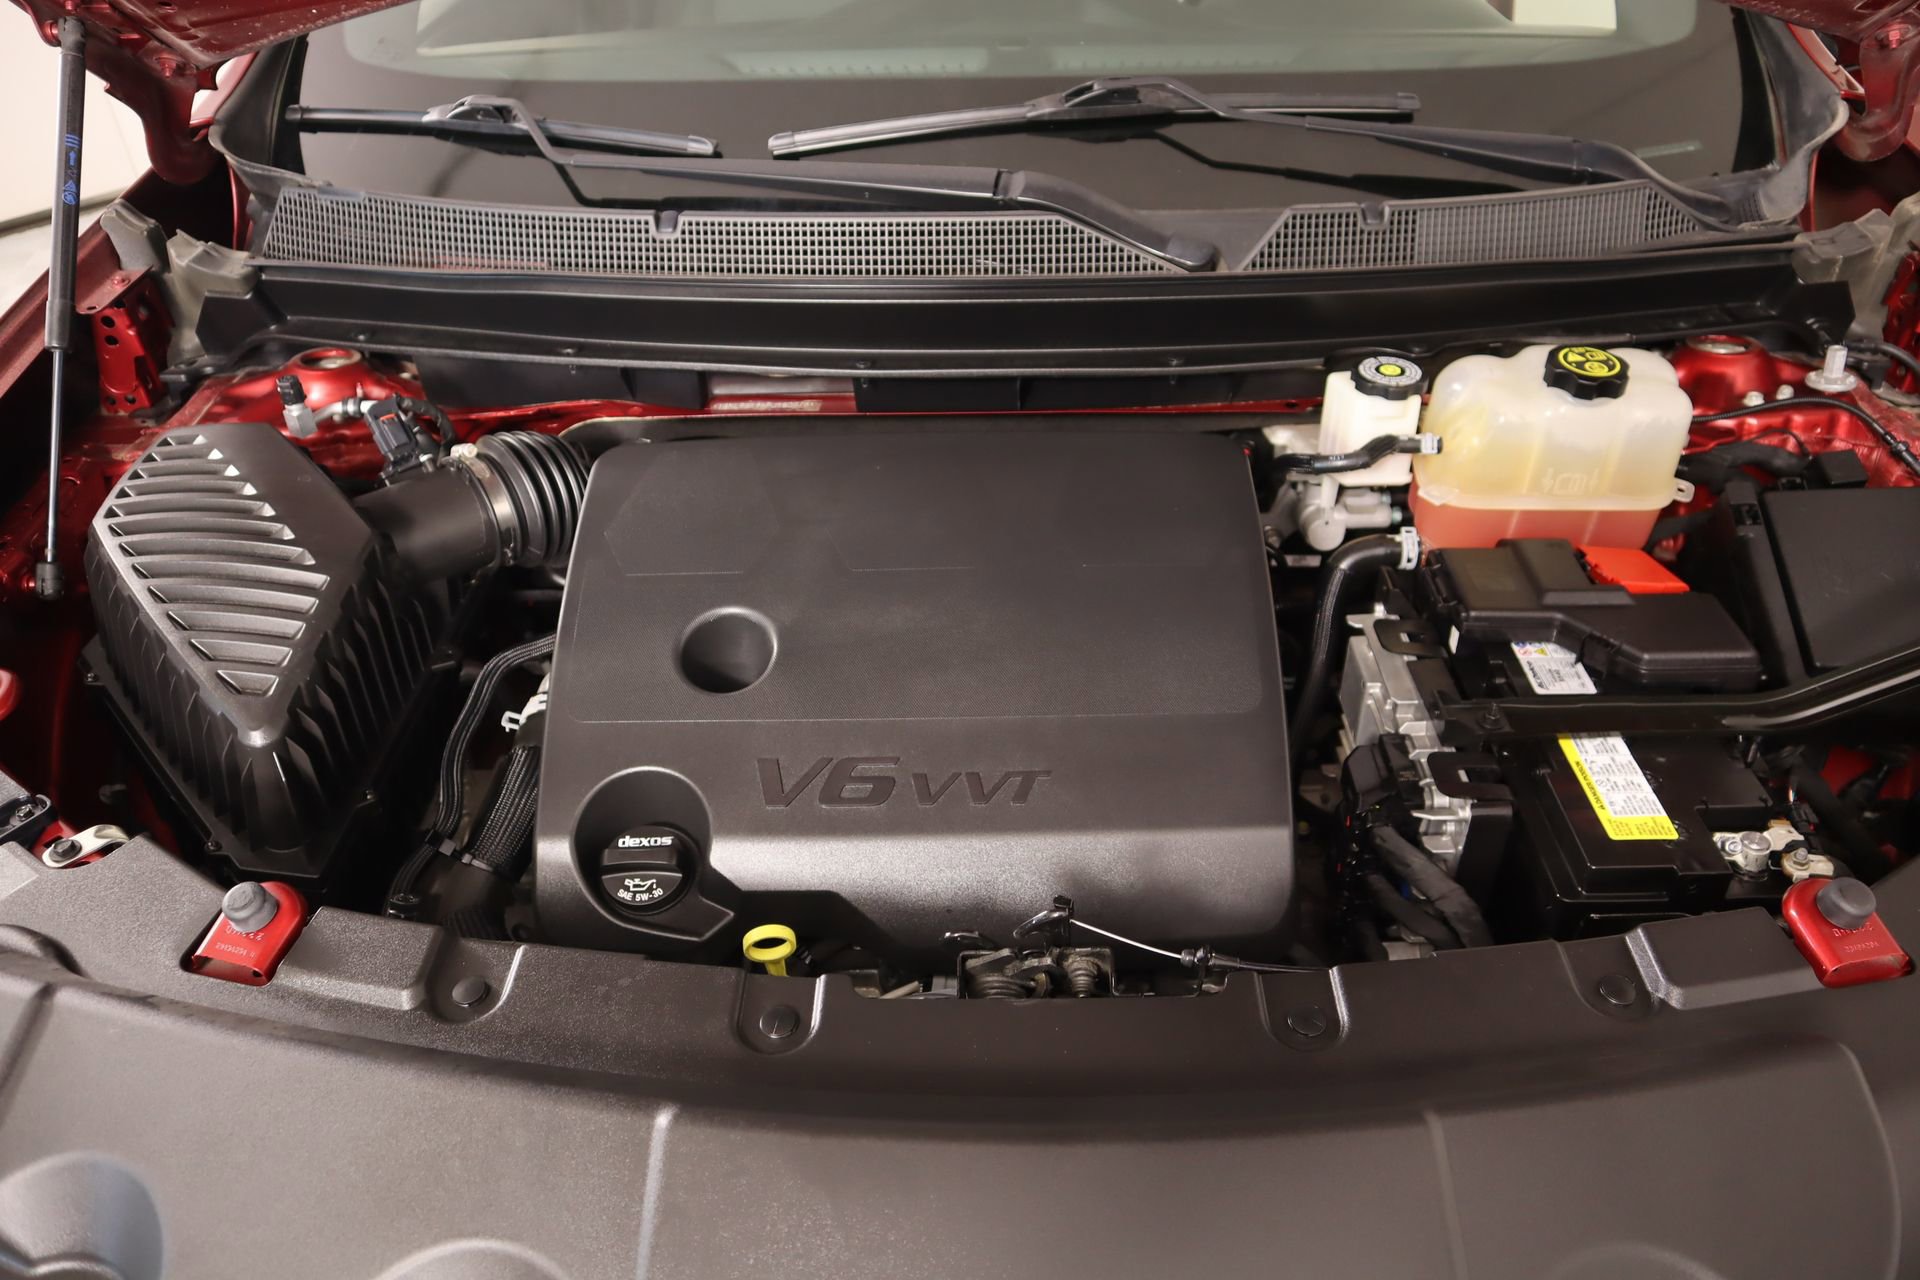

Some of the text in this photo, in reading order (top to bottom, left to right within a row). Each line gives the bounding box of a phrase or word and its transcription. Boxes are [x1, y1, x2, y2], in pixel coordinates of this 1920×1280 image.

[757, 757, 1052, 808] V6 VVT
[618, 835, 673, 848] dexos
[617, 888, 664, 902] SAE 5W-30
